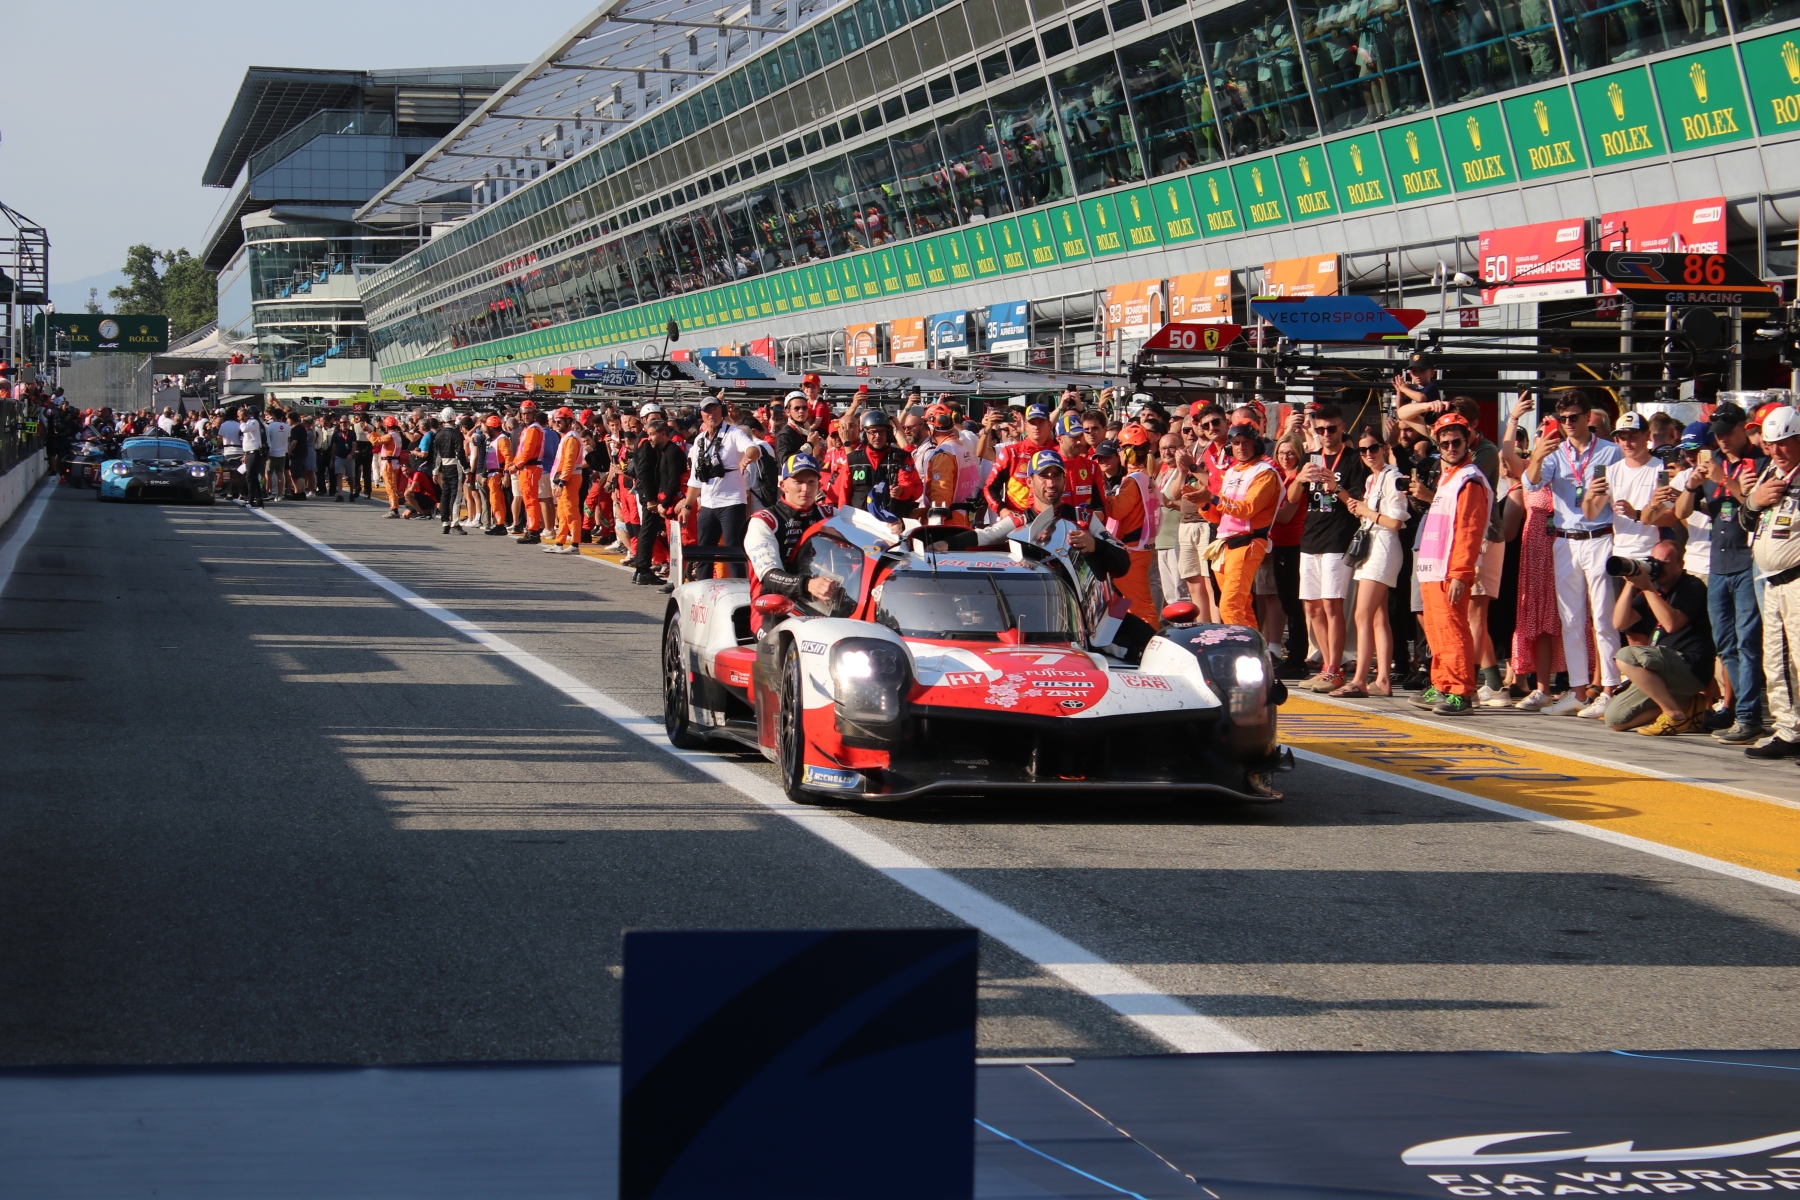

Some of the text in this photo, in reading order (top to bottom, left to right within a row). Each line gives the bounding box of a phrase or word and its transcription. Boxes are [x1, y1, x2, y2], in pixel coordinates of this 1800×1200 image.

[1682, 108, 1739, 140] ROLEX
[1602, 126, 1653, 156] ROLEX
[1528, 141, 1575, 170] ROLEX
[1462, 155, 1505, 182] ROLEX
[1403, 169, 1442, 194] ROLEX
[1348, 180, 1384, 204] ROLEX
[1297, 191, 1330, 213] ROLEX
[1250, 201, 1281, 222] ROLEX
[1167, 218, 1194, 238] ROLEX
[1207, 210, 1236, 230] ROLEX
[1096, 232, 1120, 250] ROLEX
[1130, 226, 1155, 244] ROLEX
[1032, 246, 1054, 262] ROLEX
[1063, 239, 1085, 256] ROLEX
[977, 258, 996, 273] ROLEX
[1004, 252, 1024, 268] ROLEX
[1515, 258, 1581, 277] FERRARI AF CORSE
[928, 268, 945, 282] ROLEX
[952, 263, 970, 278] ROLEX
[1485, 254, 1509, 283] 50
[1683, 254, 1725, 284] 86
[1597, 298, 1616, 311] 20
[1665, 292, 1742, 303] GR RACING
[1172, 295, 1185, 317] 21
[1461, 310, 1478, 322] 21
[987, 321, 998, 339] 35
[128, 335, 159, 343] ROLEX
[892, 334, 901, 350] 25
[1169, 329, 1196, 349] 50
[1033, 351, 1047, 360] 26
[650, 364, 672, 380] 36
[717, 360, 739, 376] 35
[856, 367, 869, 375] 54
[462, 379, 476, 391] 38
[482, 378, 498, 390] 28
[544, 378, 555, 389] 33
[602, 374, 622, 385] #25
[624, 374, 636, 382] TF
[852, 470, 866, 481] 40
[1423, 532, 1439, 541] LANE
[801, 641, 827, 655] AISIN
[948, 673, 983, 686] HY
[1024, 668, 1086, 678] FUJITSU
[1121, 674, 1163, 682] HYPER
[1126, 679, 1168, 690] CAR
[813, 772, 855, 784] MICHELIN
[1427, 1173, 1547, 1185] FIA
